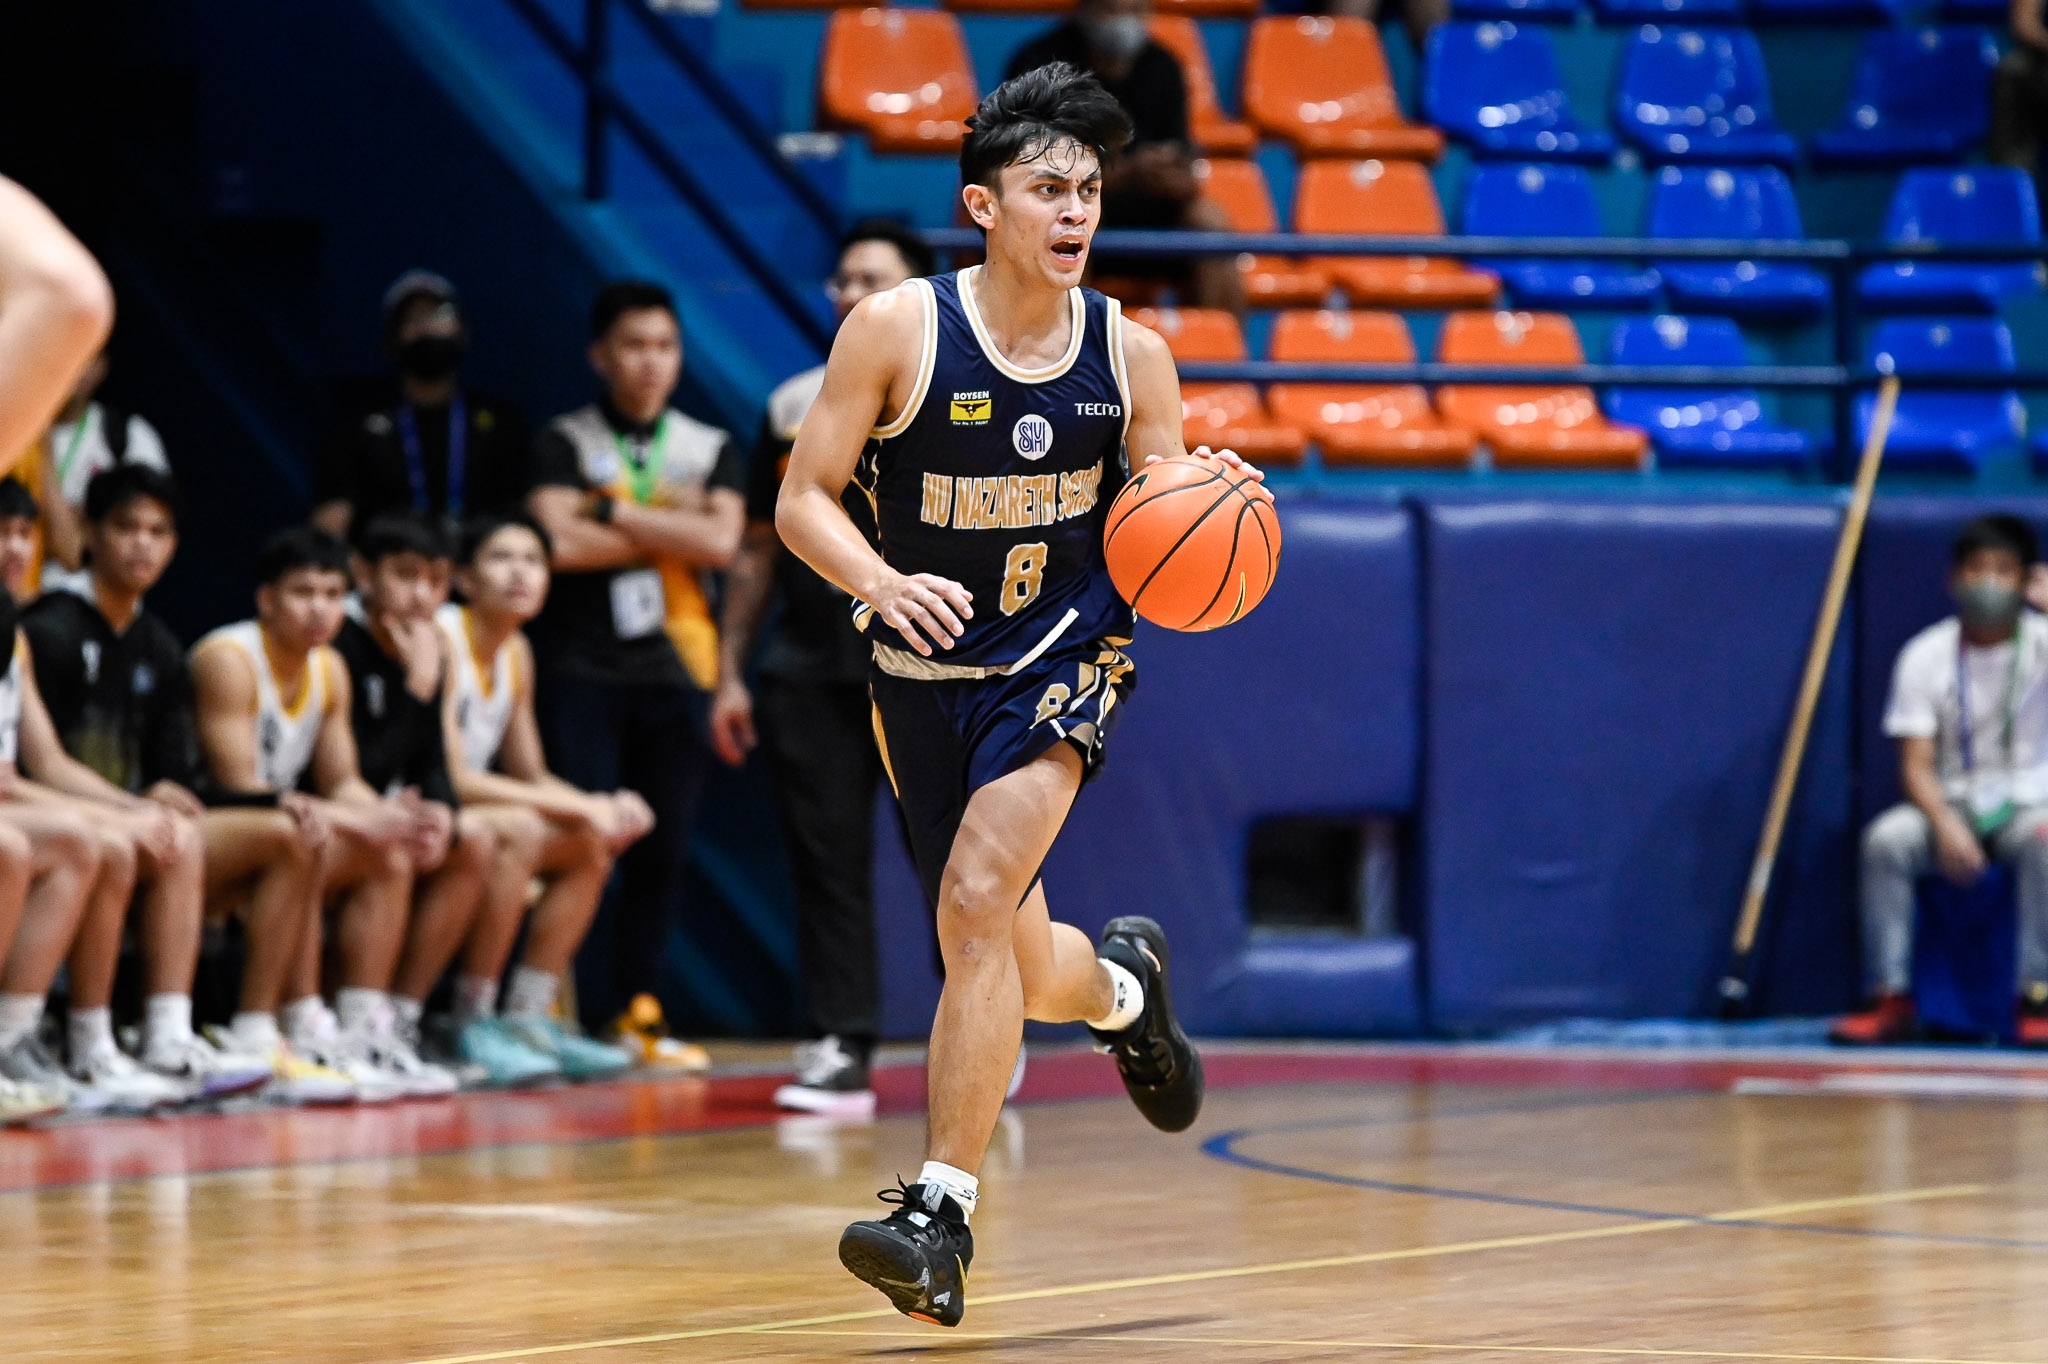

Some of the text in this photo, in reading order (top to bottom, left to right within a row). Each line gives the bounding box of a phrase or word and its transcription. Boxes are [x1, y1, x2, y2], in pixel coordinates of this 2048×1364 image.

[953, 390, 990, 400] BOYSEN
[1074, 403, 1121, 417] TECNO
[920, 472, 953, 528] NU
[953, 473, 1057, 530] NAZARETH
[1000, 541, 1048, 616] 8
